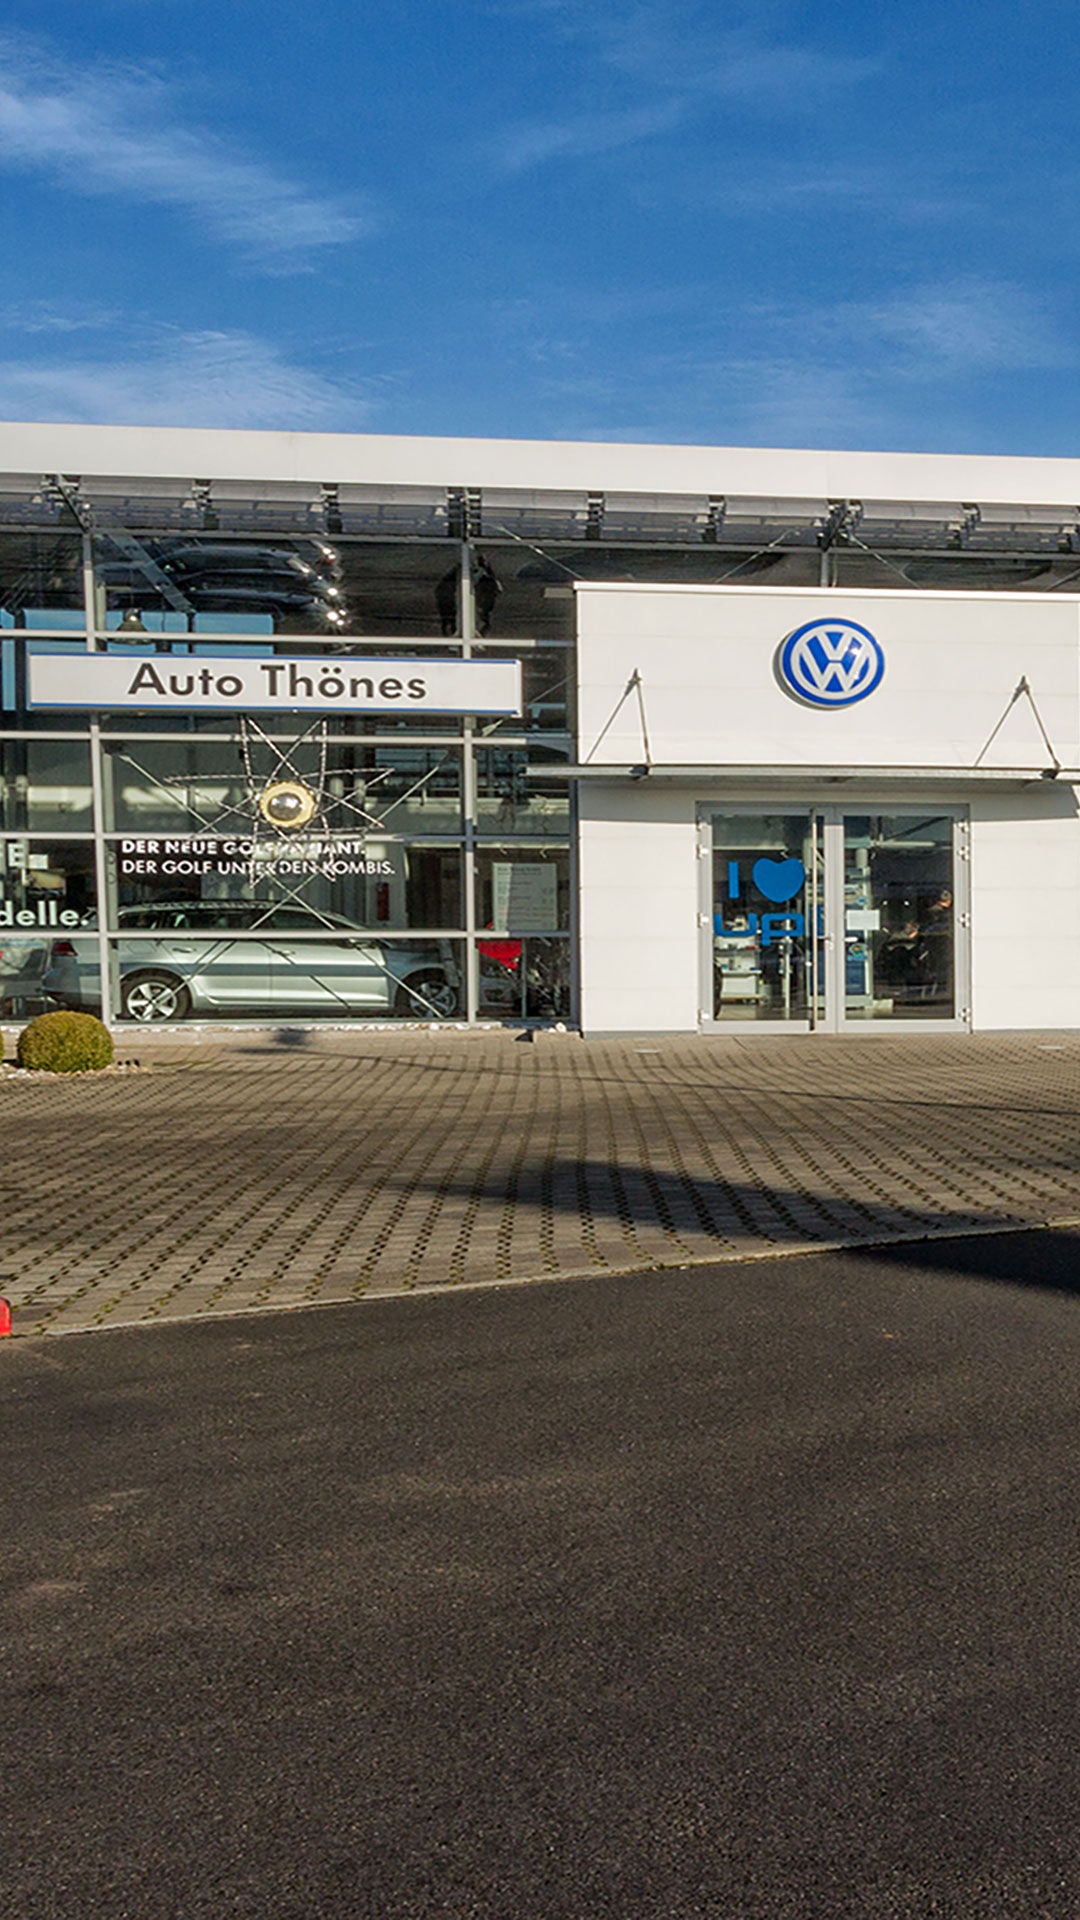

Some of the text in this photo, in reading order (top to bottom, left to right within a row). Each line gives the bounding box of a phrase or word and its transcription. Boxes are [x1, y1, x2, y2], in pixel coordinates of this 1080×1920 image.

[128, 662, 427, 700] Auto Thönes
[121, 840, 160, 855] DER
[165, 840, 218, 855] NEUE
[121, 860, 396, 875] DER GOLF UNTER DEN KOMBIS.
[728, 862, 739, 899] I
